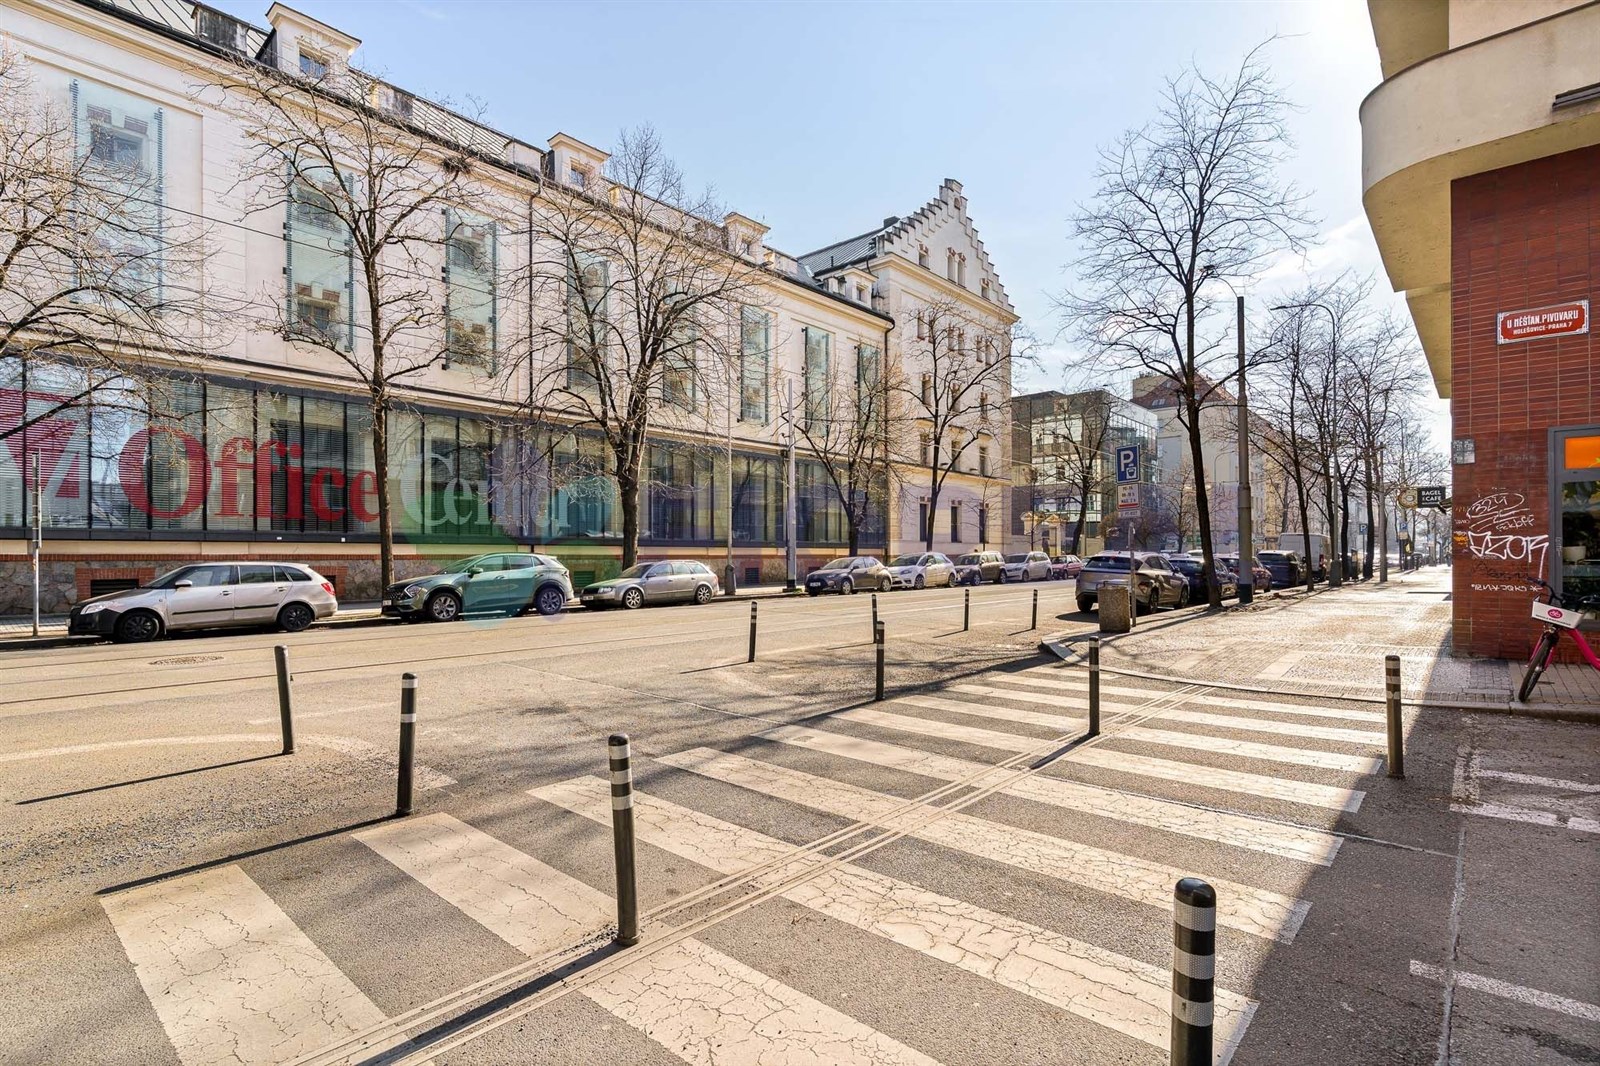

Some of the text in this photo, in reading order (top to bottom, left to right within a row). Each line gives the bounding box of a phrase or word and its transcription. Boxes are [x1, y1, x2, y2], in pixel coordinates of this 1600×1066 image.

[1507, 319, 1512, 328] U
[1542, 309, 1579, 324] PIVOVARU
[1120, 450, 1134, 472] P
[118, 425, 380, 523] Office
